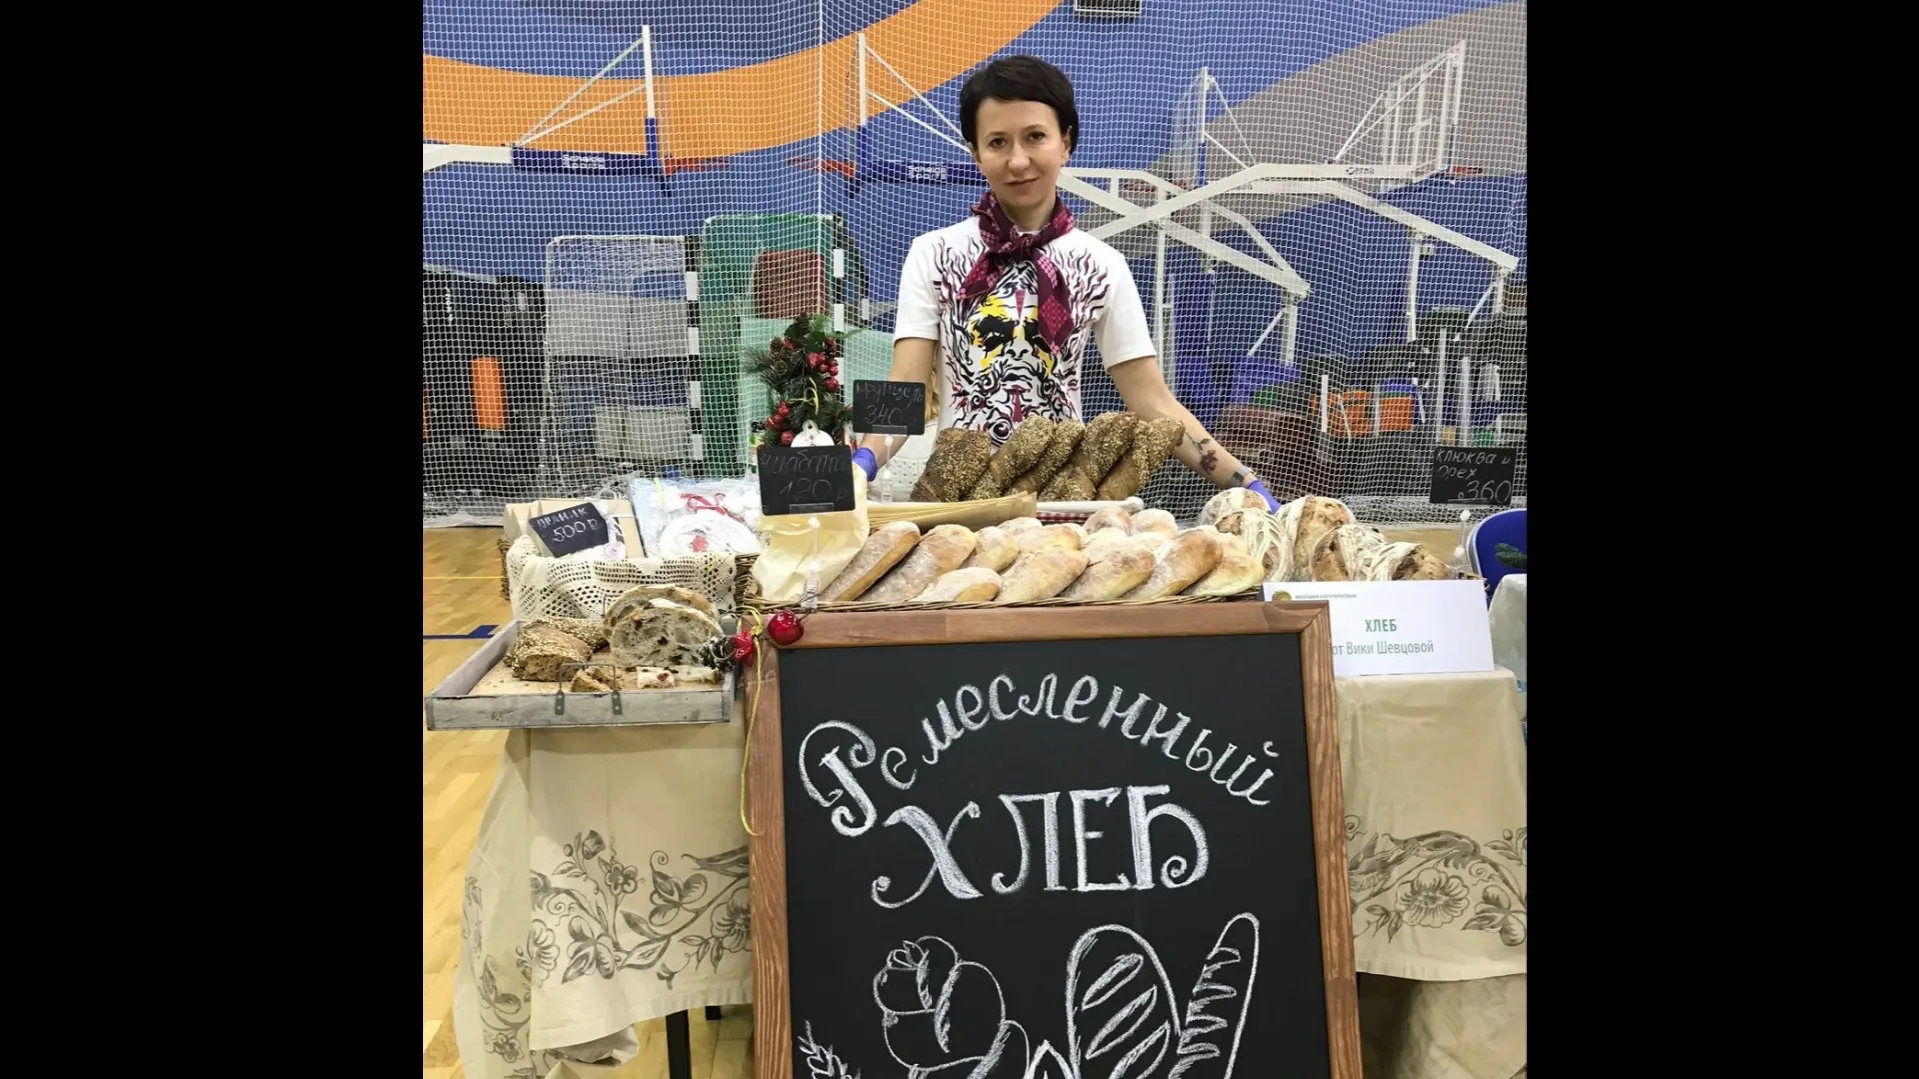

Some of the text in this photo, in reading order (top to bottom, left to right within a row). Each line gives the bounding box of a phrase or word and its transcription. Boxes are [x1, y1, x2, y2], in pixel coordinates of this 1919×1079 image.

[864, 404, 904, 425] 340
[1467, 480, 1512, 503] 360
[1364, 619, 1397, 632] ХЛЕБ
[1331, 640, 1434, 655] от Вики Шевцовой
[799, 673, 1279, 836] Ремесленный
[872, 785, 1209, 908] ХЛЕБ
